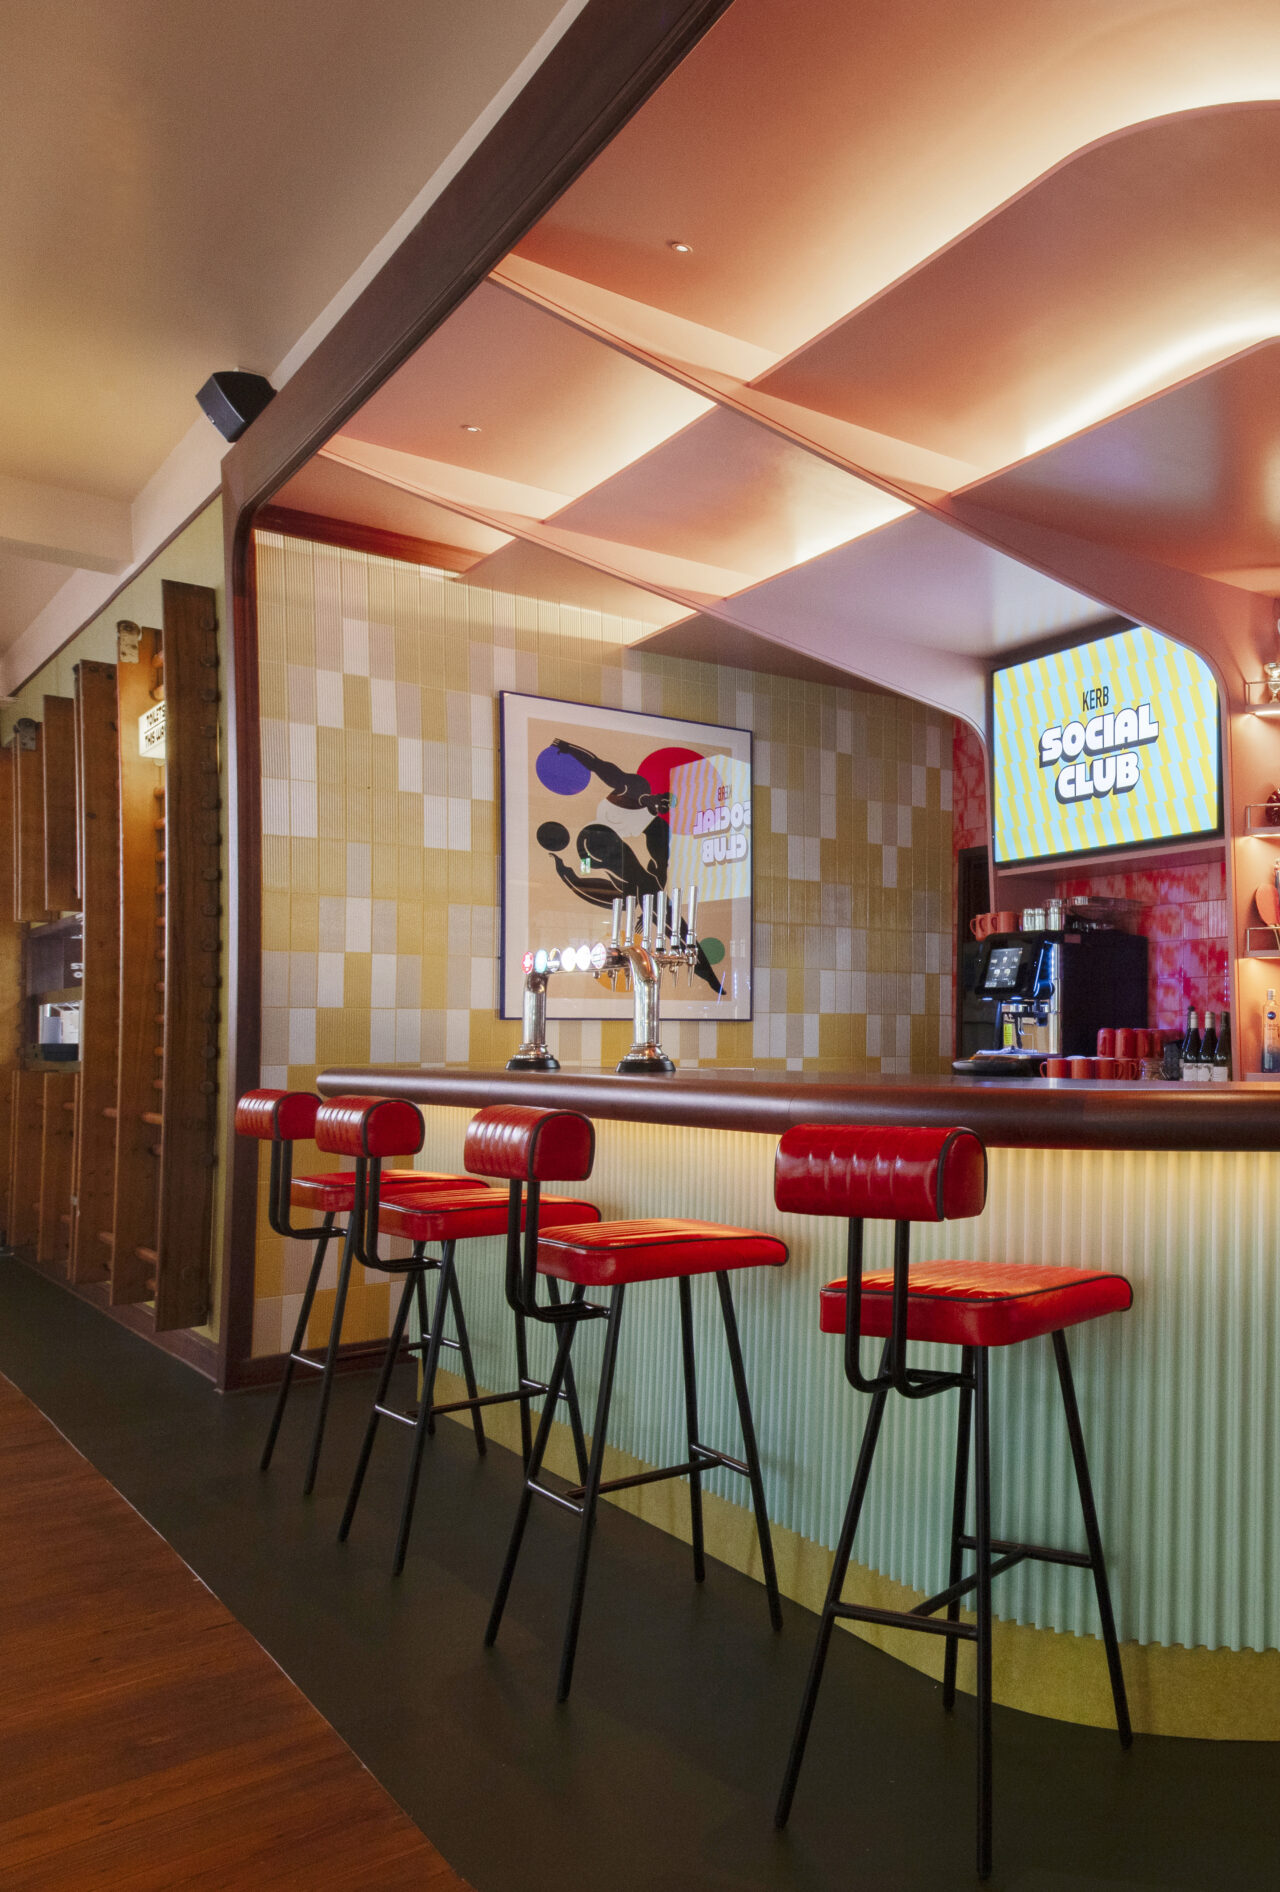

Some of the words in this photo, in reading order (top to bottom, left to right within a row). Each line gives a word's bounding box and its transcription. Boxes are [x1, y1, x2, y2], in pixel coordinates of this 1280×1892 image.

[1082, 686, 1109, 712] KERB
[145, 731, 155, 748] THIS
[1039, 703, 1159, 768] SOCIAL
[1055, 752, 1140, 805] CLUB
